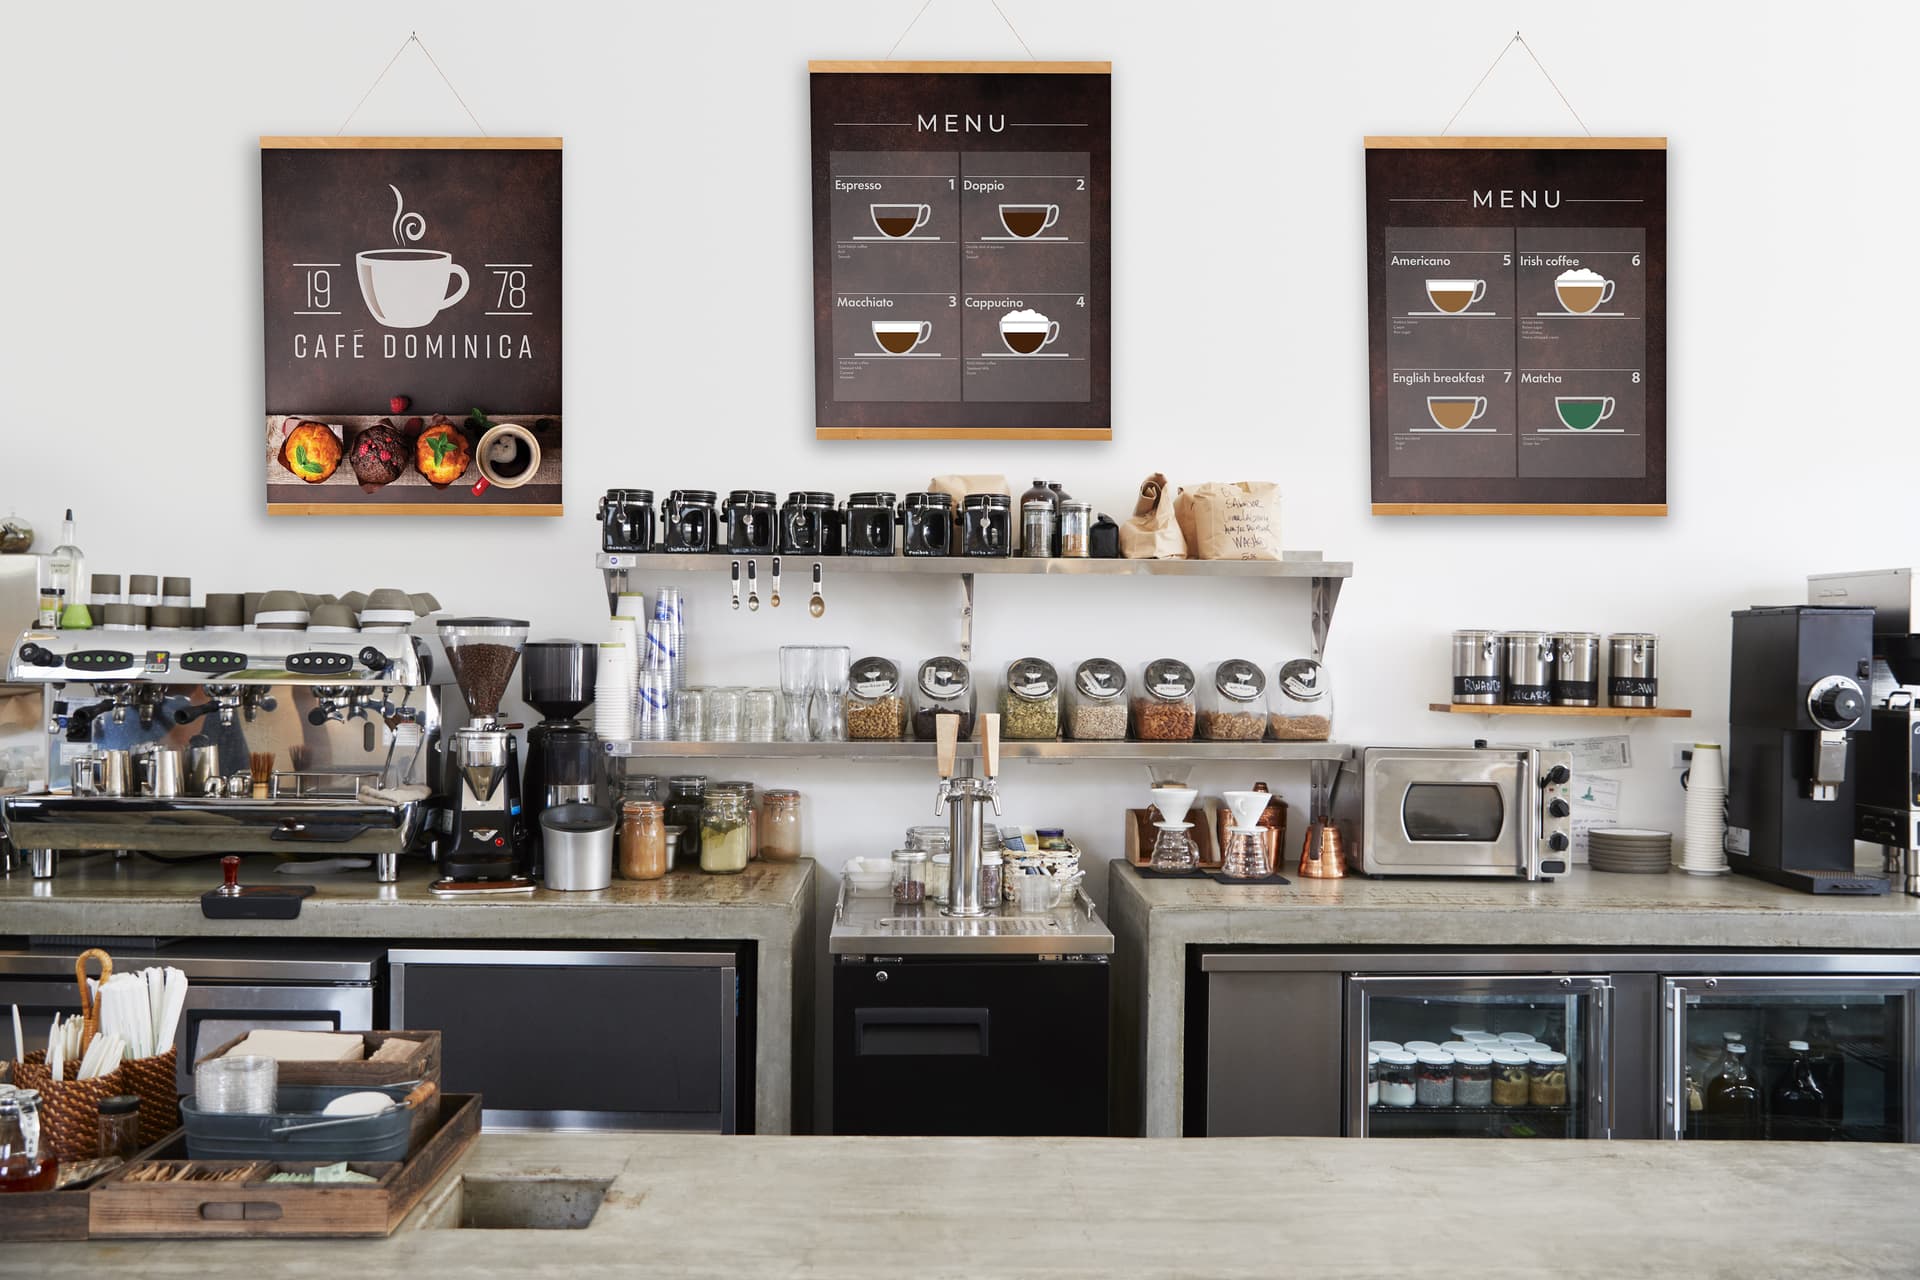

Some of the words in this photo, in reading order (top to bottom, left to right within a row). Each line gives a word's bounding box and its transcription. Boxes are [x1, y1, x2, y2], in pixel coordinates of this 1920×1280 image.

[917, 113, 1005, 133] MENU
[834, 179, 882, 192] Espresso
[948, 178, 955, 191] 1
[963, 179, 1005, 193] Doppio
[1076, 178, 1085, 191] 2
[1473, 189, 1560, 209] MENU
[1390, 255, 1451, 266] Americano
[1503, 254, 1512, 266] 5
[1520, 255, 1543, 266] Irish
[1545, 255, 1580, 266] coffee
[1631, 254, 1641, 266] 6
[306, 270, 332, 308] 19
[493, 270, 527, 309] 78
[836, 296, 894, 308] Macchiato
[948, 295, 957, 308] 3
[964, 297, 1024, 311] Cappucino
[1075, 296, 1086, 308] 4
[294, 328, 365, 359] CAFÉ
[383, 334, 533, 359] DOMINICA
[1392, 371, 1431, 385] English
[1433, 371, 1485, 383] breakfast
[1503, 371, 1513, 383] 7
[1520, 372, 1562, 383] Matcha
[1631, 371, 1641, 383] 8
